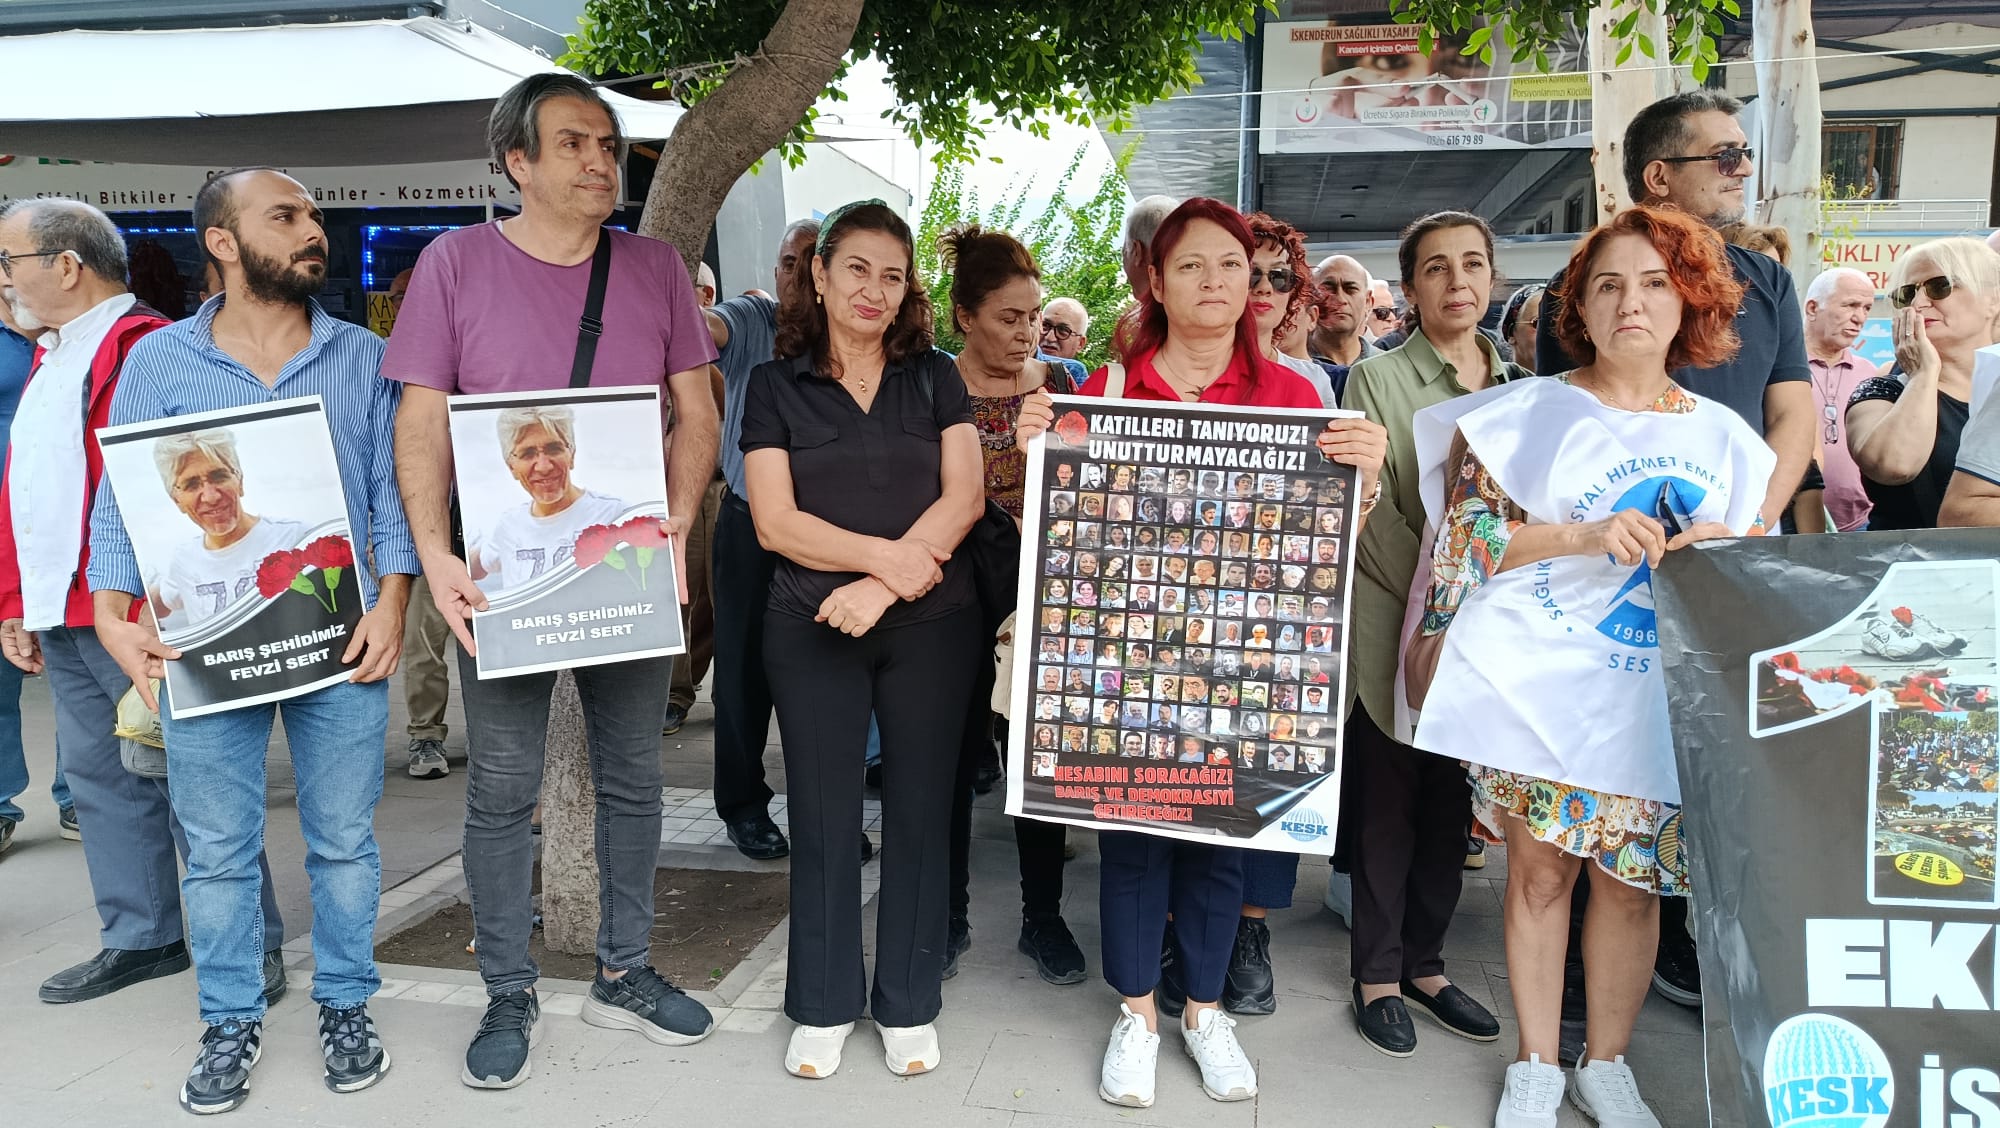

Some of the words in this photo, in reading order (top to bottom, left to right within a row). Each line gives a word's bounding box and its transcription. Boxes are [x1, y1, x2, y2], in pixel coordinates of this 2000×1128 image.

[1291, 27, 1343, 42] İSKENDERUN
[1344, 26, 1380, 41] SAĞLIKLI
[1382, 25, 1410, 39] YAŞAM
[100, 190, 176, 205] Bitkiler
[308, 186, 368, 201] ünler
[398, 185, 497, 200] Kozmetik
[1090, 414, 1184, 439] KATİLLERİ
[1190, 419, 1309, 445] TANIYORUZ!
[1088, 439, 1307, 471] UNUTTURMAYACAĞIZ!
[1606, 455, 1677, 484] HİZMET
[511, 613, 564, 630] BARIŞ
[567, 602, 654, 626] ŞEHİDİMİZ
[535, 628, 586, 646] FEVZİ
[590, 624, 634, 639] SERT
[1612, 622, 1657, 644] 1996
[203, 647, 256, 666] BARIŞ
[258, 623, 347, 659] ŞEHİDİMİZ
[230, 658, 282, 681] FEVZİ
[285, 648, 330, 670] SERT
[1608, 653, 1652, 673] SES
[1054, 765, 1129, 783] HESABINI
[1134, 765, 1234, 786] SORACAĞIZ!
[1055, 786, 1101, 803] BARIŞ
[1105, 787, 1126, 802] VE
[1128, 787, 1234, 806] DEMOKRASİYİ
[1093, 803, 1193, 822] GETİRECEĞİZ!
[1281, 821, 1329, 836] KESK
[1805, 917, 2000, 1011] EK
[1768, 1076, 1890, 1128] KESK
